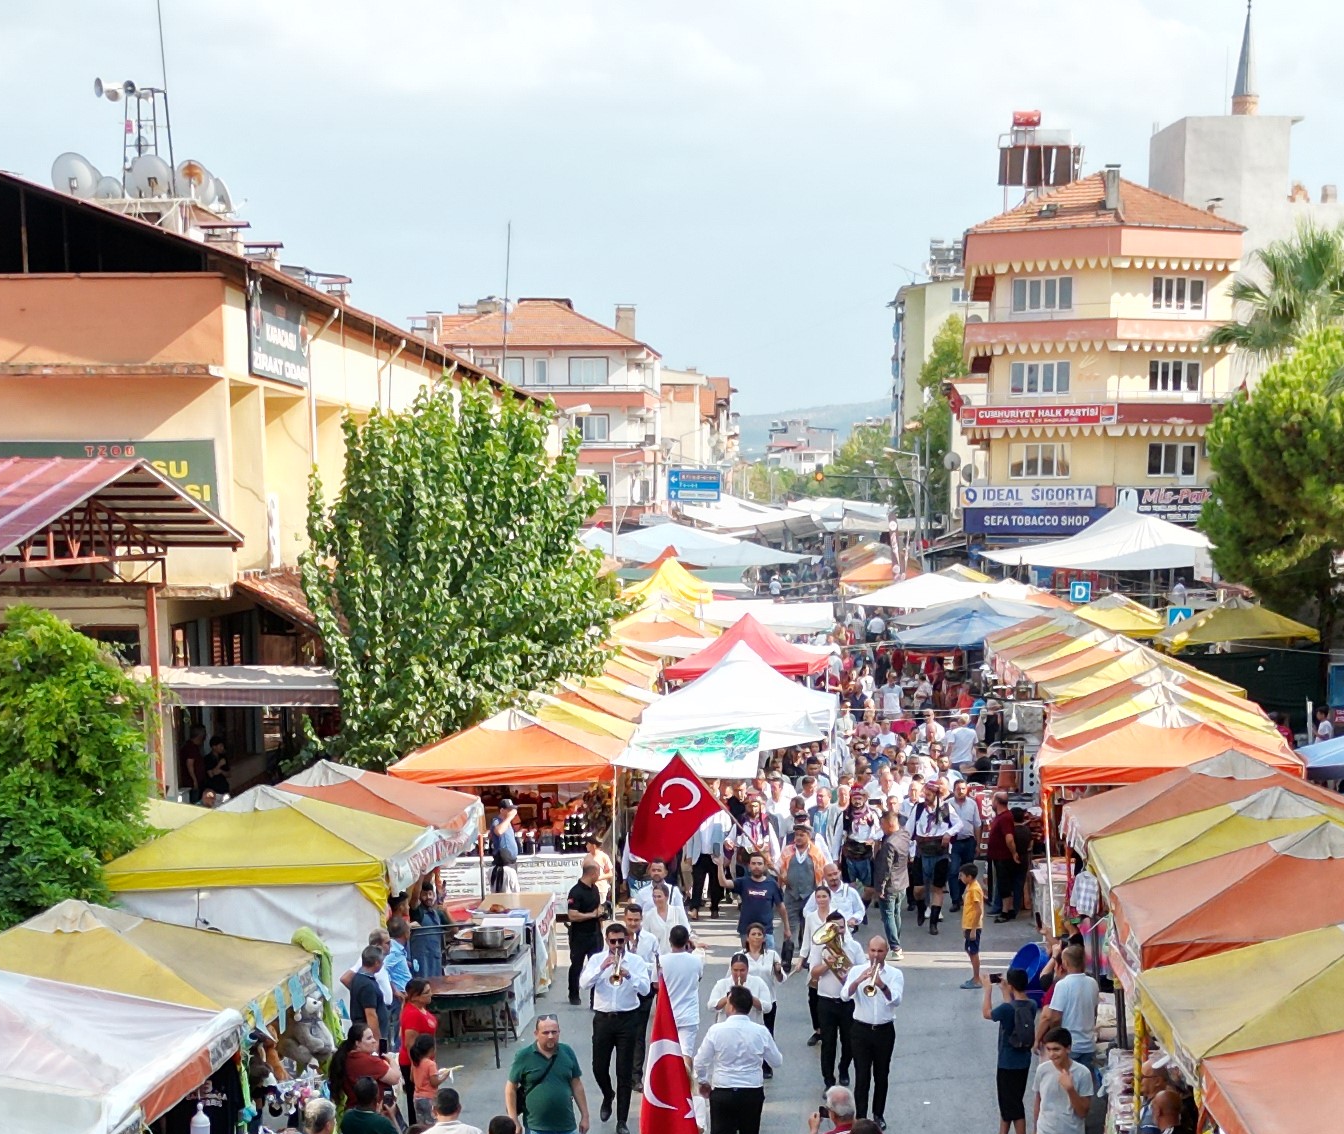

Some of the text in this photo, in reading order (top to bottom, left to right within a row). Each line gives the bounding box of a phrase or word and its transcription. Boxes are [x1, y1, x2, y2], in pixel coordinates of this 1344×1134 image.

[1038, 407, 1062, 418] HALK
[1064, 405, 1099, 417] PARTİSİ
[983, 515, 1090, 526] SEFA TOBACCO SHOP
[1074, 585, 1086, 599] D
